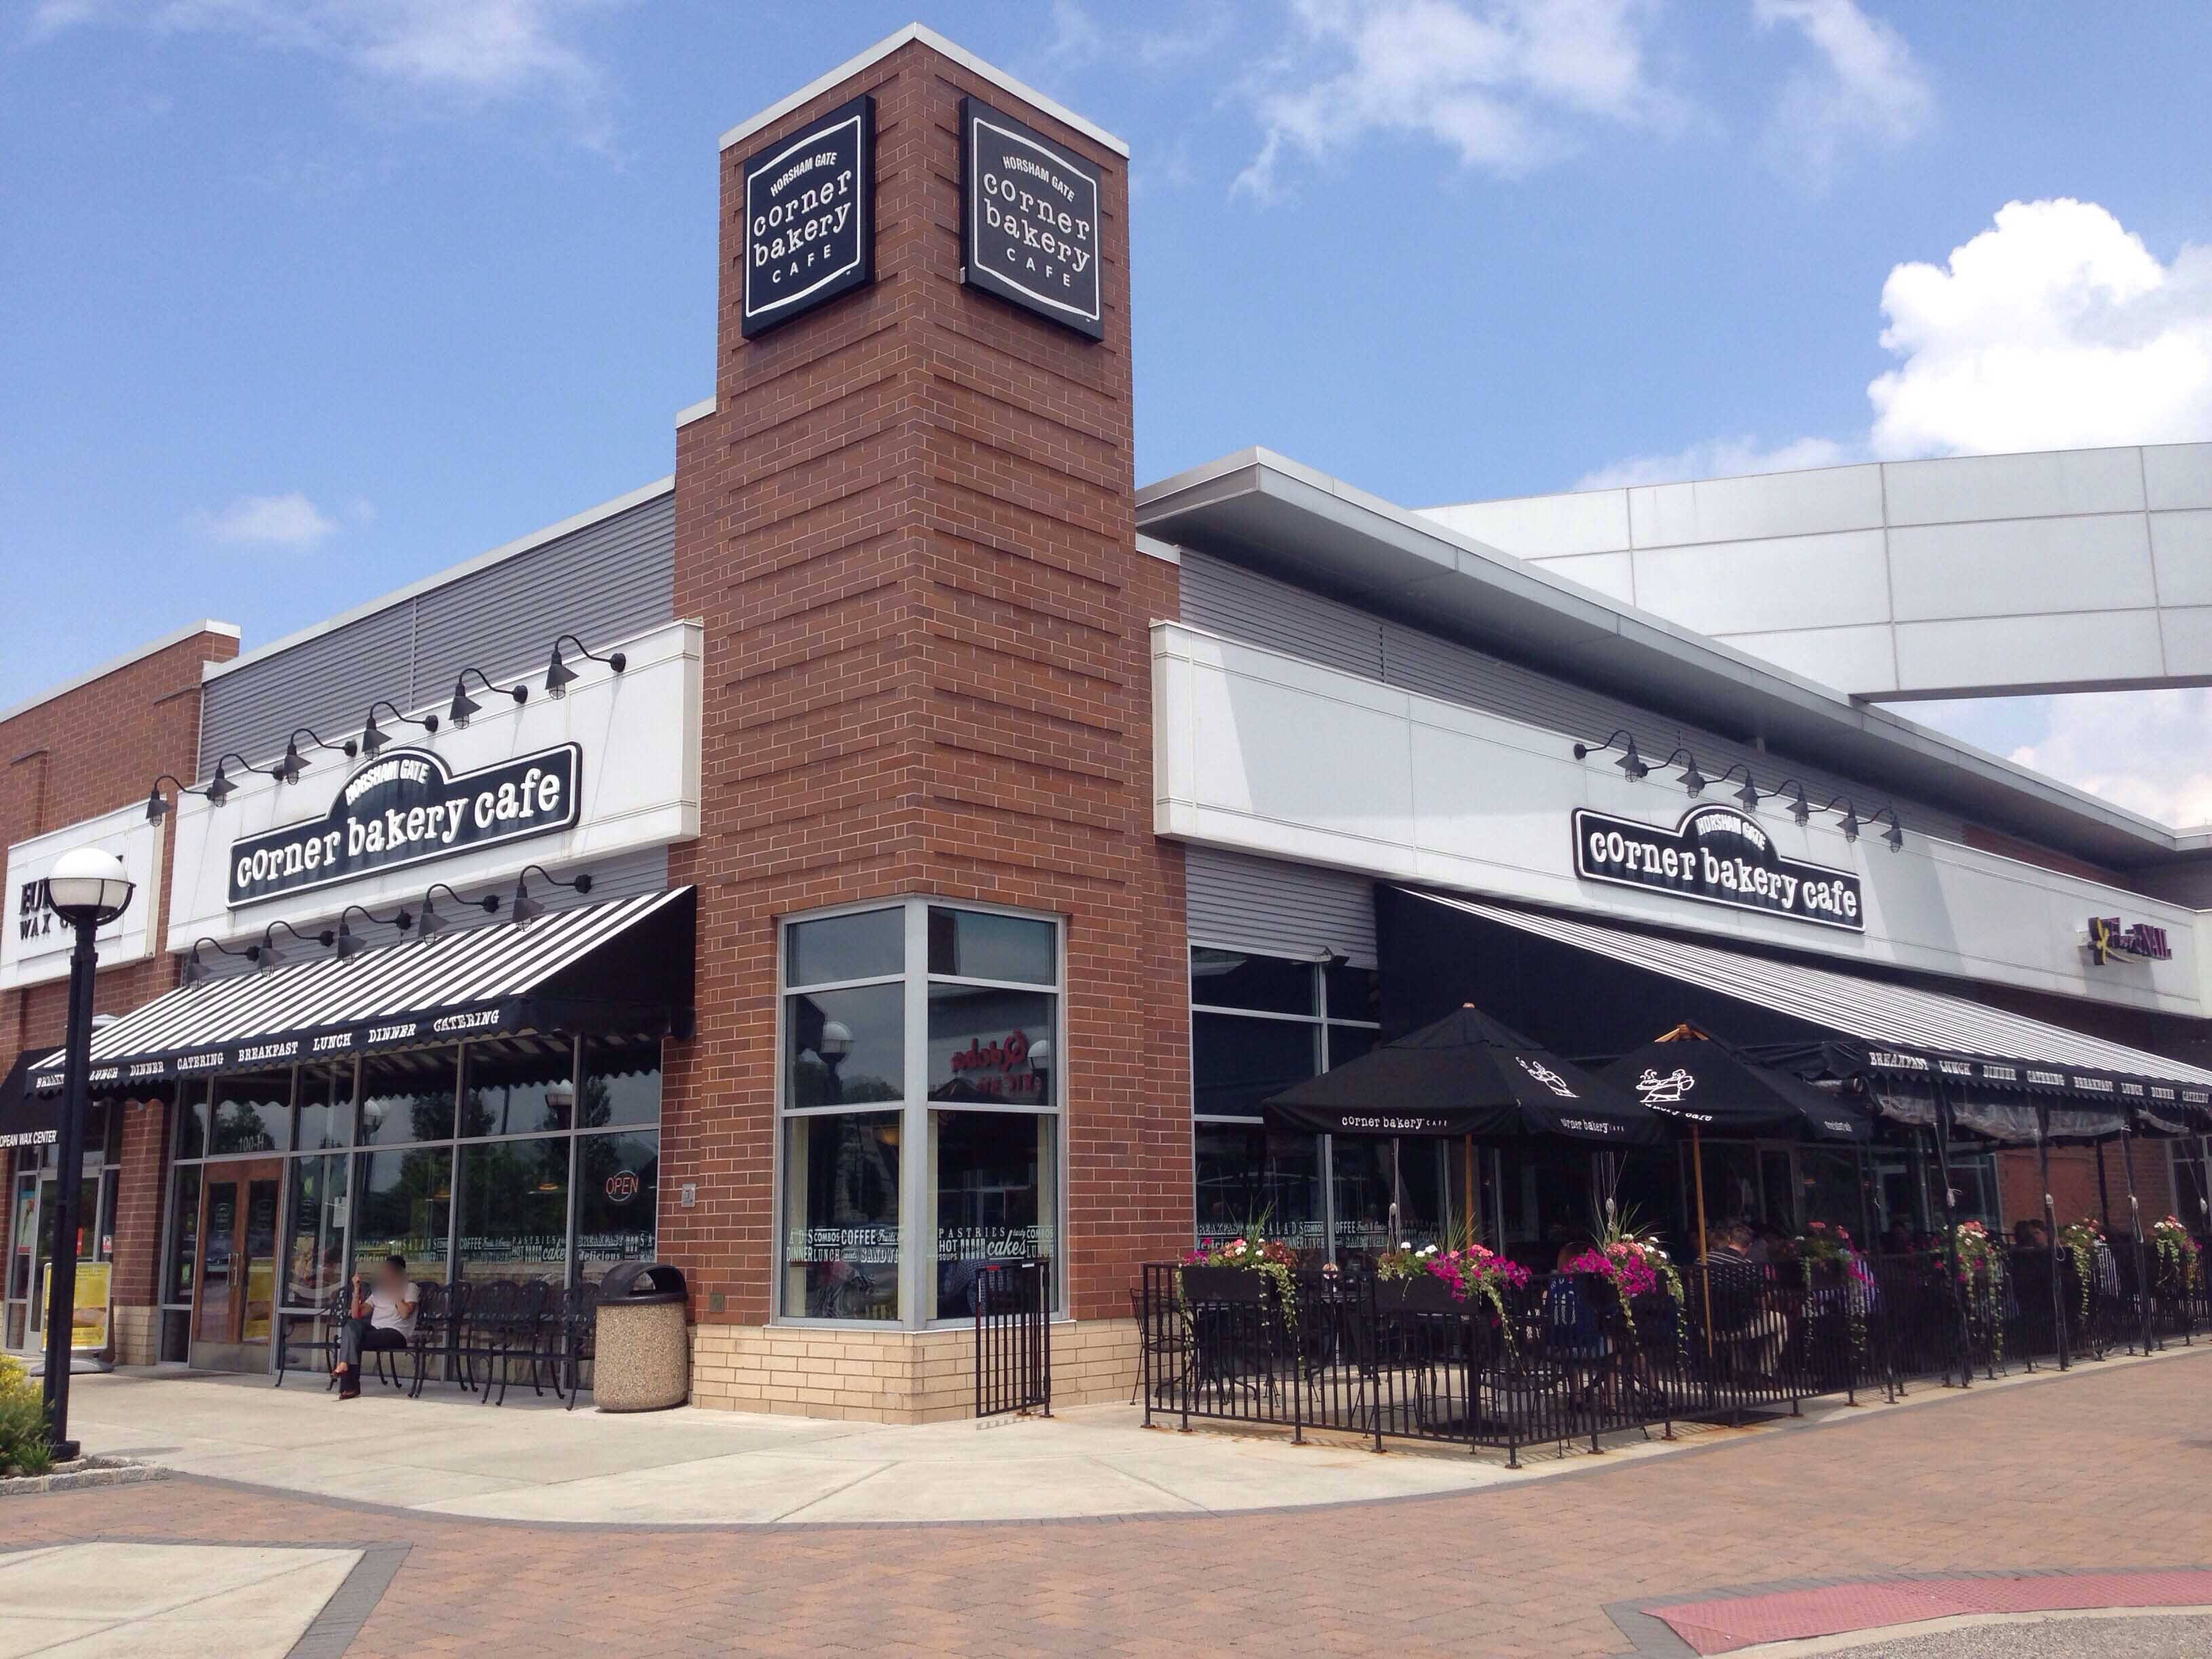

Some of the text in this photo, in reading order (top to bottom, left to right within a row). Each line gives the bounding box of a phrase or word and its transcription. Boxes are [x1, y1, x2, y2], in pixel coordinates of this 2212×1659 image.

[770, 152, 838, 198] HORSHAM GATE
[1002, 155, 1075, 203] HORSHAM GATE
[753, 169, 852, 237] corner
[983, 172, 1090, 241] corner
[754, 202, 851, 268] bakery
[983, 198, 1091, 273] bakery
[772, 243, 832, 284] CAFE
[1006, 247, 1071, 288] CAFE
[346, 758, 432, 806] HORSHAM GATE
[237, 767, 561, 888] corner bakery cafe
[1696, 814, 1767, 852] HORSHAM GATE
[1590, 831, 1858, 918] corner bakery cafe
[20, 912, 52, 941] WAX
[89, 1067, 119, 1082] LUNCH
[129, 1061, 164, 1077] DINNER
[177, 1052, 224, 1071] CATERING
[238, 1041, 299, 1063] BREAKFAST
[313, 1033, 352, 1052] LUNCH
[368, 1023, 417, 1043] DINNER
[433, 1009, 500, 1033] CATERING
[1868, 1051, 1930, 1071] BREAKFAST
[1938, 1060, 1972, 1076] LUNCH
[1982, 1064, 2018, 1081] DINNER
[2026, 1069, 2066, 1086] CATERING
[2121, 1082, 2144, 1097] LUNCH
[2150, 1086, 2175, 1100] DINNER
[1341, 1115, 1380, 1128] corner
[1382, 1116, 1425, 1130] bakery
[19, 1130, 33, 1145] WAX
[33, 1130, 56, 1144] CENTER
[605, 1176, 639, 1195] OPEN
[814, 1231, 840, 1242] COMBOS
[841, 1229, 876, 1245] COFFEE
[939, 1227, 1006, 1239] PASTRIES
[1026, 1228, 1054, 1240] COMBOS
[1334, 1221, 1356, 1234] OFFEE
[459, 1237, 483, 1250] COFFEE
[542, 1237, 567, 1261] cake
[578, 1250, 621, 1261] delicious
[786, 1246, 813, 1263] DINNER
[813, 1248, 840, 1263] LUNCH
[938, 1239, 958, 1252] HOT
[987, 1229, 1027, 1256] cakes
[939, 1252, 958, 1261] SOUPS
[1026, 1244, 1054, 1258] LUNCH
